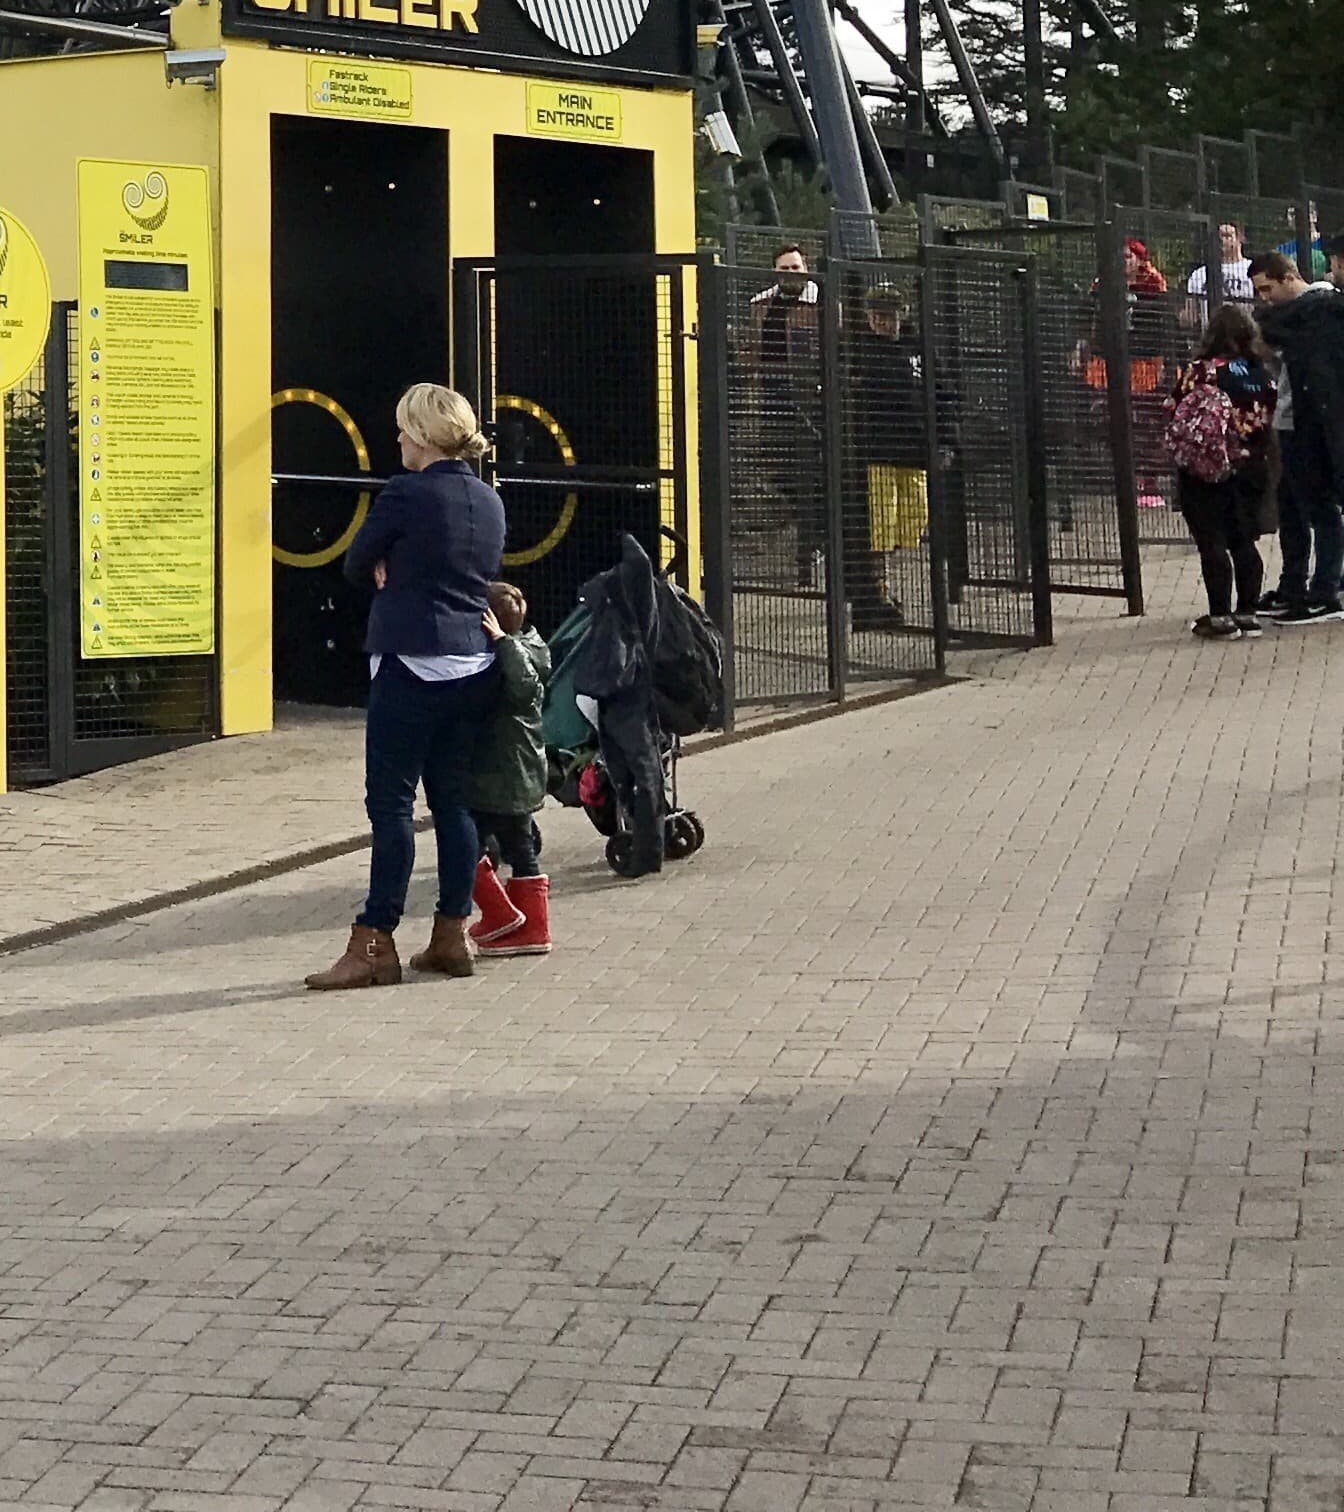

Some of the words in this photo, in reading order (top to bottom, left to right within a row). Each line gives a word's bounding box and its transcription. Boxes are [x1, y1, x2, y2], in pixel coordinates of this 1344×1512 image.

[329, 69, 368, 81] Fastrack
[329, 81, 357, 94] Single
[358, 84, 387, 96] Riders
[329, 93, 371, 105] Ambulant
[372, 97, 410, 110] Disabled
[558, 93, 592, 110] MAIN
[537, 108, 614, 131] ENTRANCE
[120, 233, 153, 244] SMILER
[2, 318, 24, 328] least
